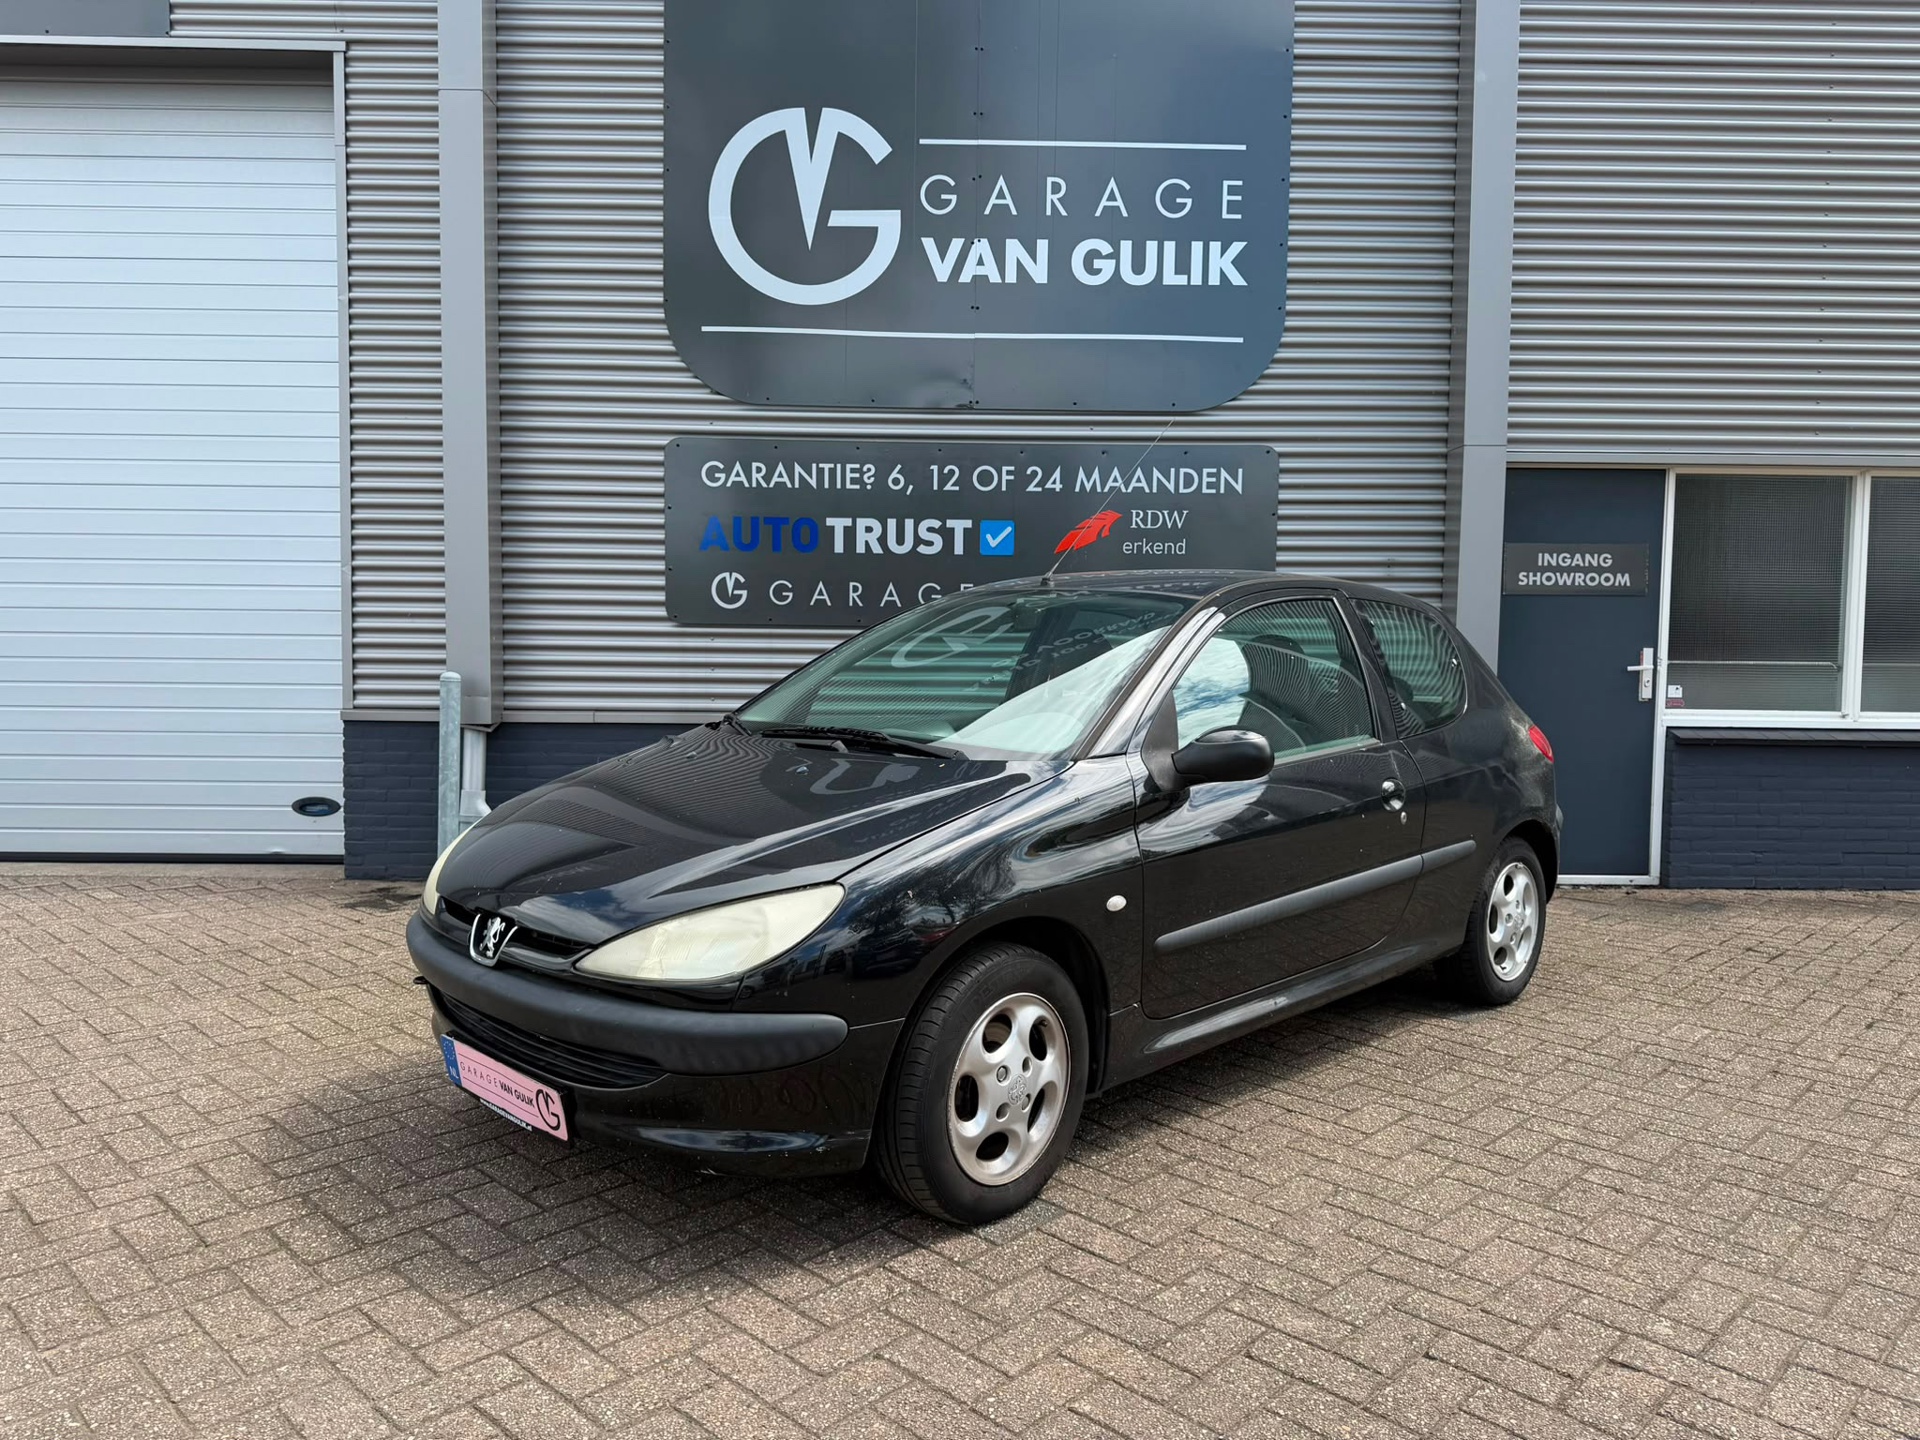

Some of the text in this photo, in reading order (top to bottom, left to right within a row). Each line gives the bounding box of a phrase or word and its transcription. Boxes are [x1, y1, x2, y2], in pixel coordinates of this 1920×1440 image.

[919, 174, 1244, 219] GARAGE
[920, 237, 1248, 286] VAN GULIK
[700, 461, 1243, 495] GARANTIE? 6, 12 OF 24 MAANDEN
[1130, 510, 1189, 529] RDW
[699, 515, 972, 555] AUTO TRUST
[1122, 538, 1186, 555] erkend
[1537, 553, 1613, 567] INGANG
[1518, 572, 1631, 587] SHOWROOM
[769, 580, 974, 607] GARAG
[449, 1066, 459, 1079] NL
[460, 1061, 535, 1108] GARAGE VAN GULIK
